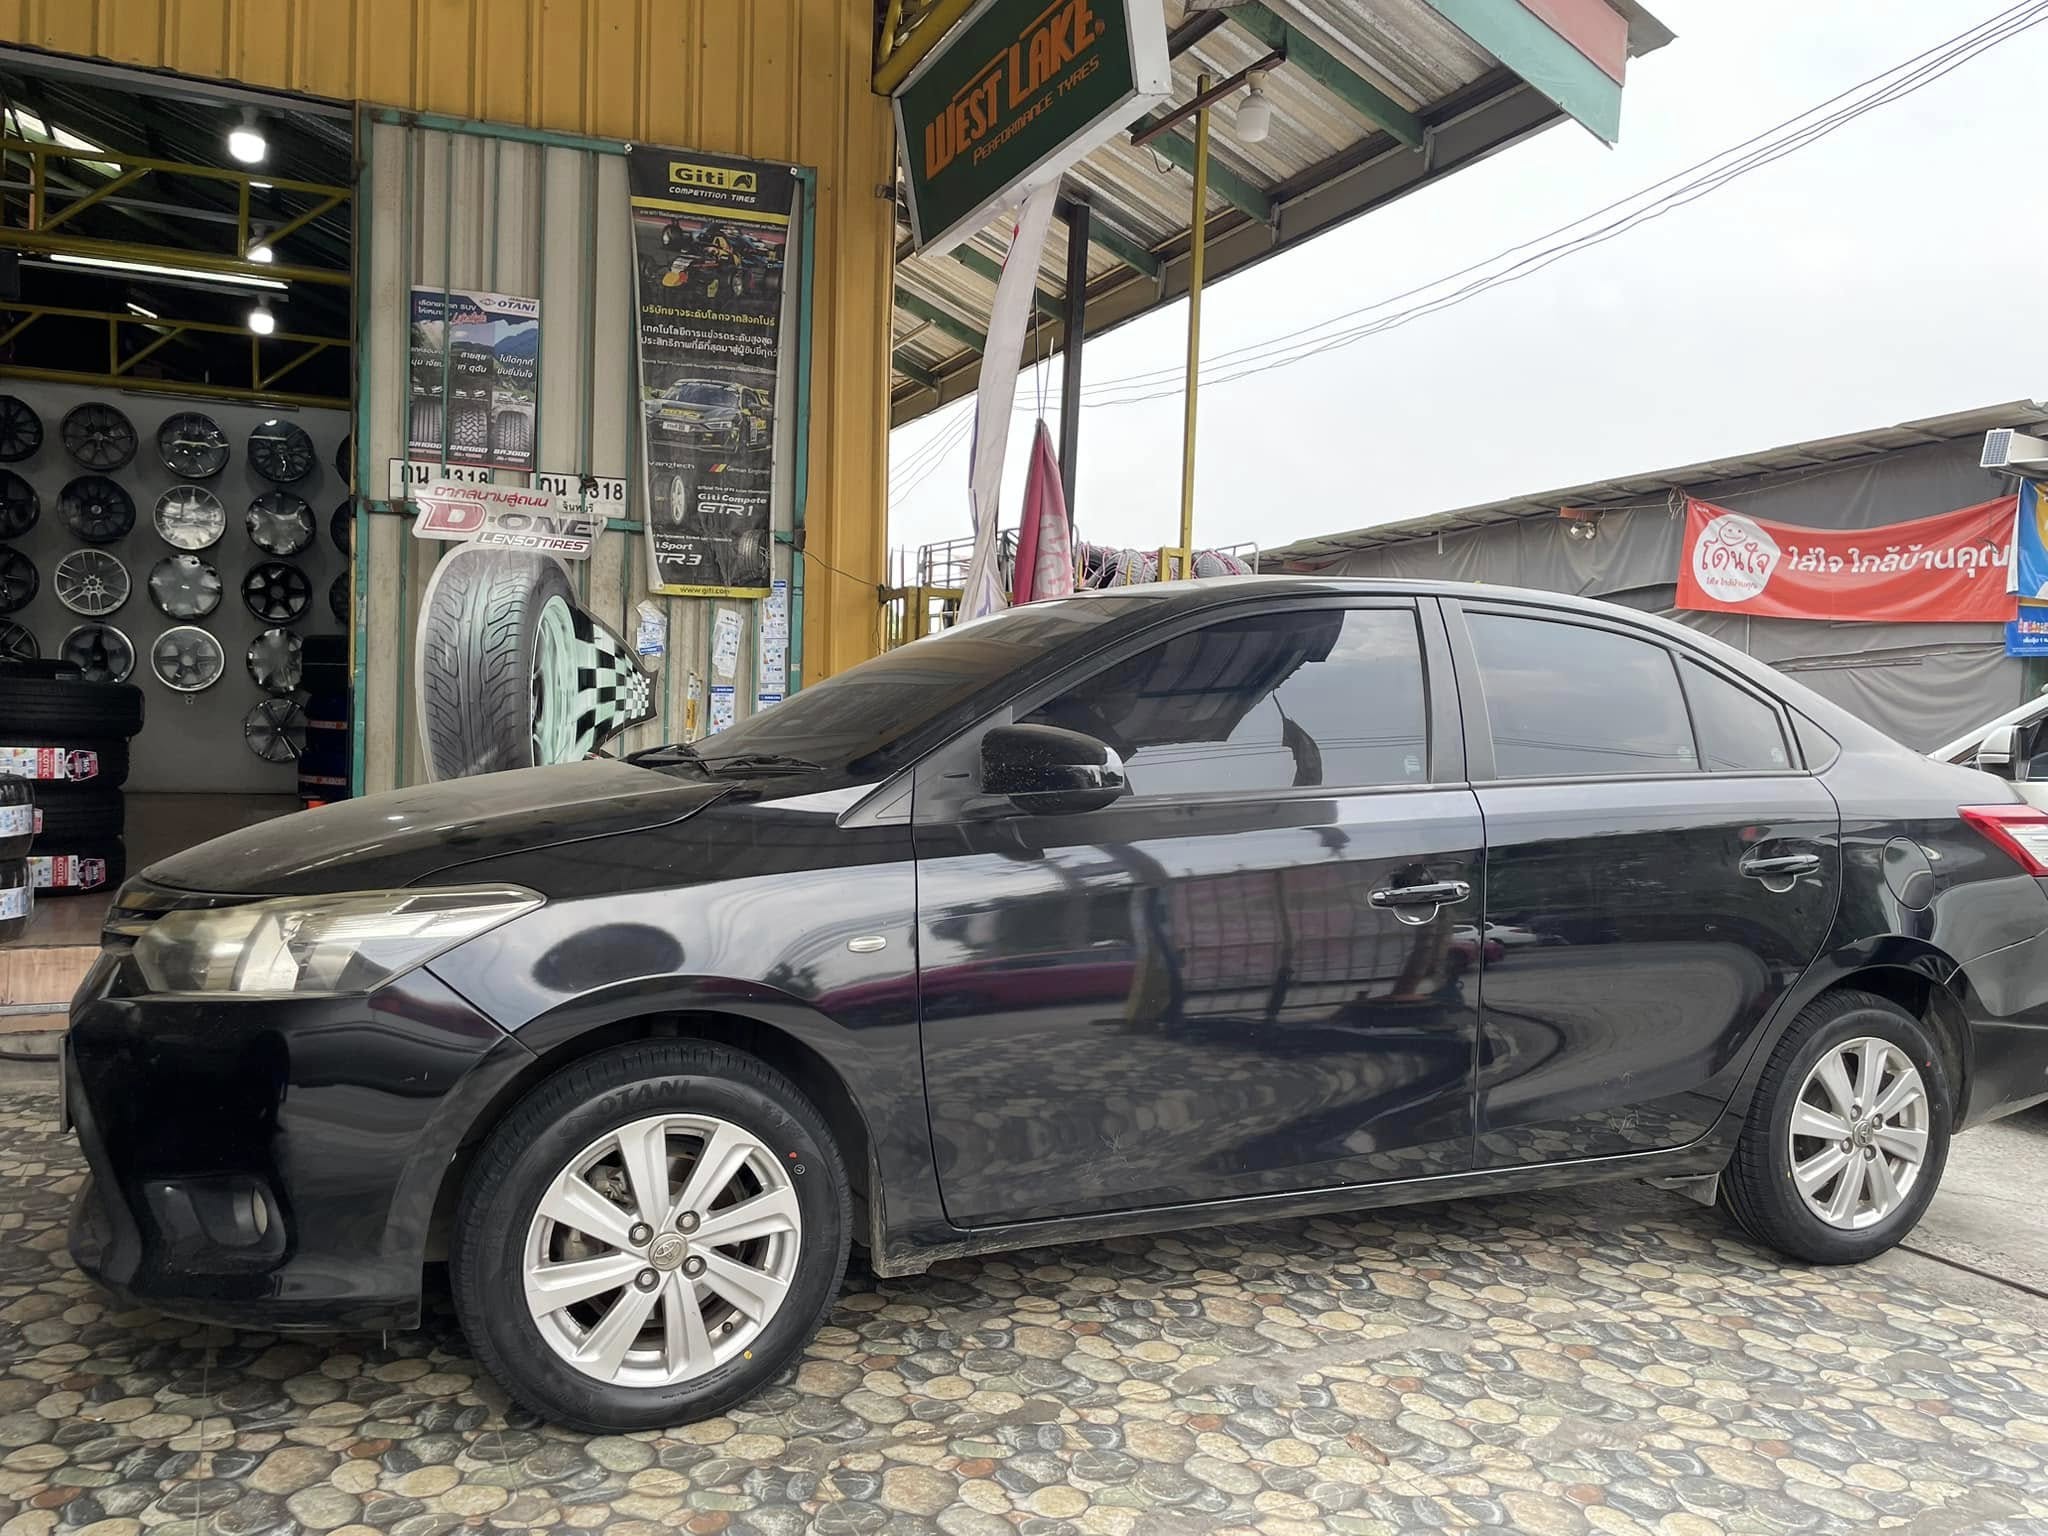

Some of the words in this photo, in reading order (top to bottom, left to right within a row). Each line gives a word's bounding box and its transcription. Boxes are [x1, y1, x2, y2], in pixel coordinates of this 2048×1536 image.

[973, 92, 1054, 166] PERFORMANCE
[1057, 54, 1100, 97] TYRES
[674, 167, 725, 186] Giti
[460, 303, 477, 312] SUV
[498, 300, 536, 313] OTANI
[697, 493, 720, 501] Giti
[722, 494, 767, 505] Compete
[480, 532, 538, 548] LENSO
[541, 537, 590, 552] TIRES
[661, 541, 693, 551] Sport
[655, 553, 702, 566] TR3
[1702, 537, 1770, 575] โดนใจ
[1788, 544, 1844, 574] ใส่ใจ
[1848, 543, 2011, 578] ใกล้บ้านคุณ
[42, 749, 50, 778] ECOTEC
[56, 857, 65, 886] ECOTEC
[600, 1079, 690, 1115] OTANI
